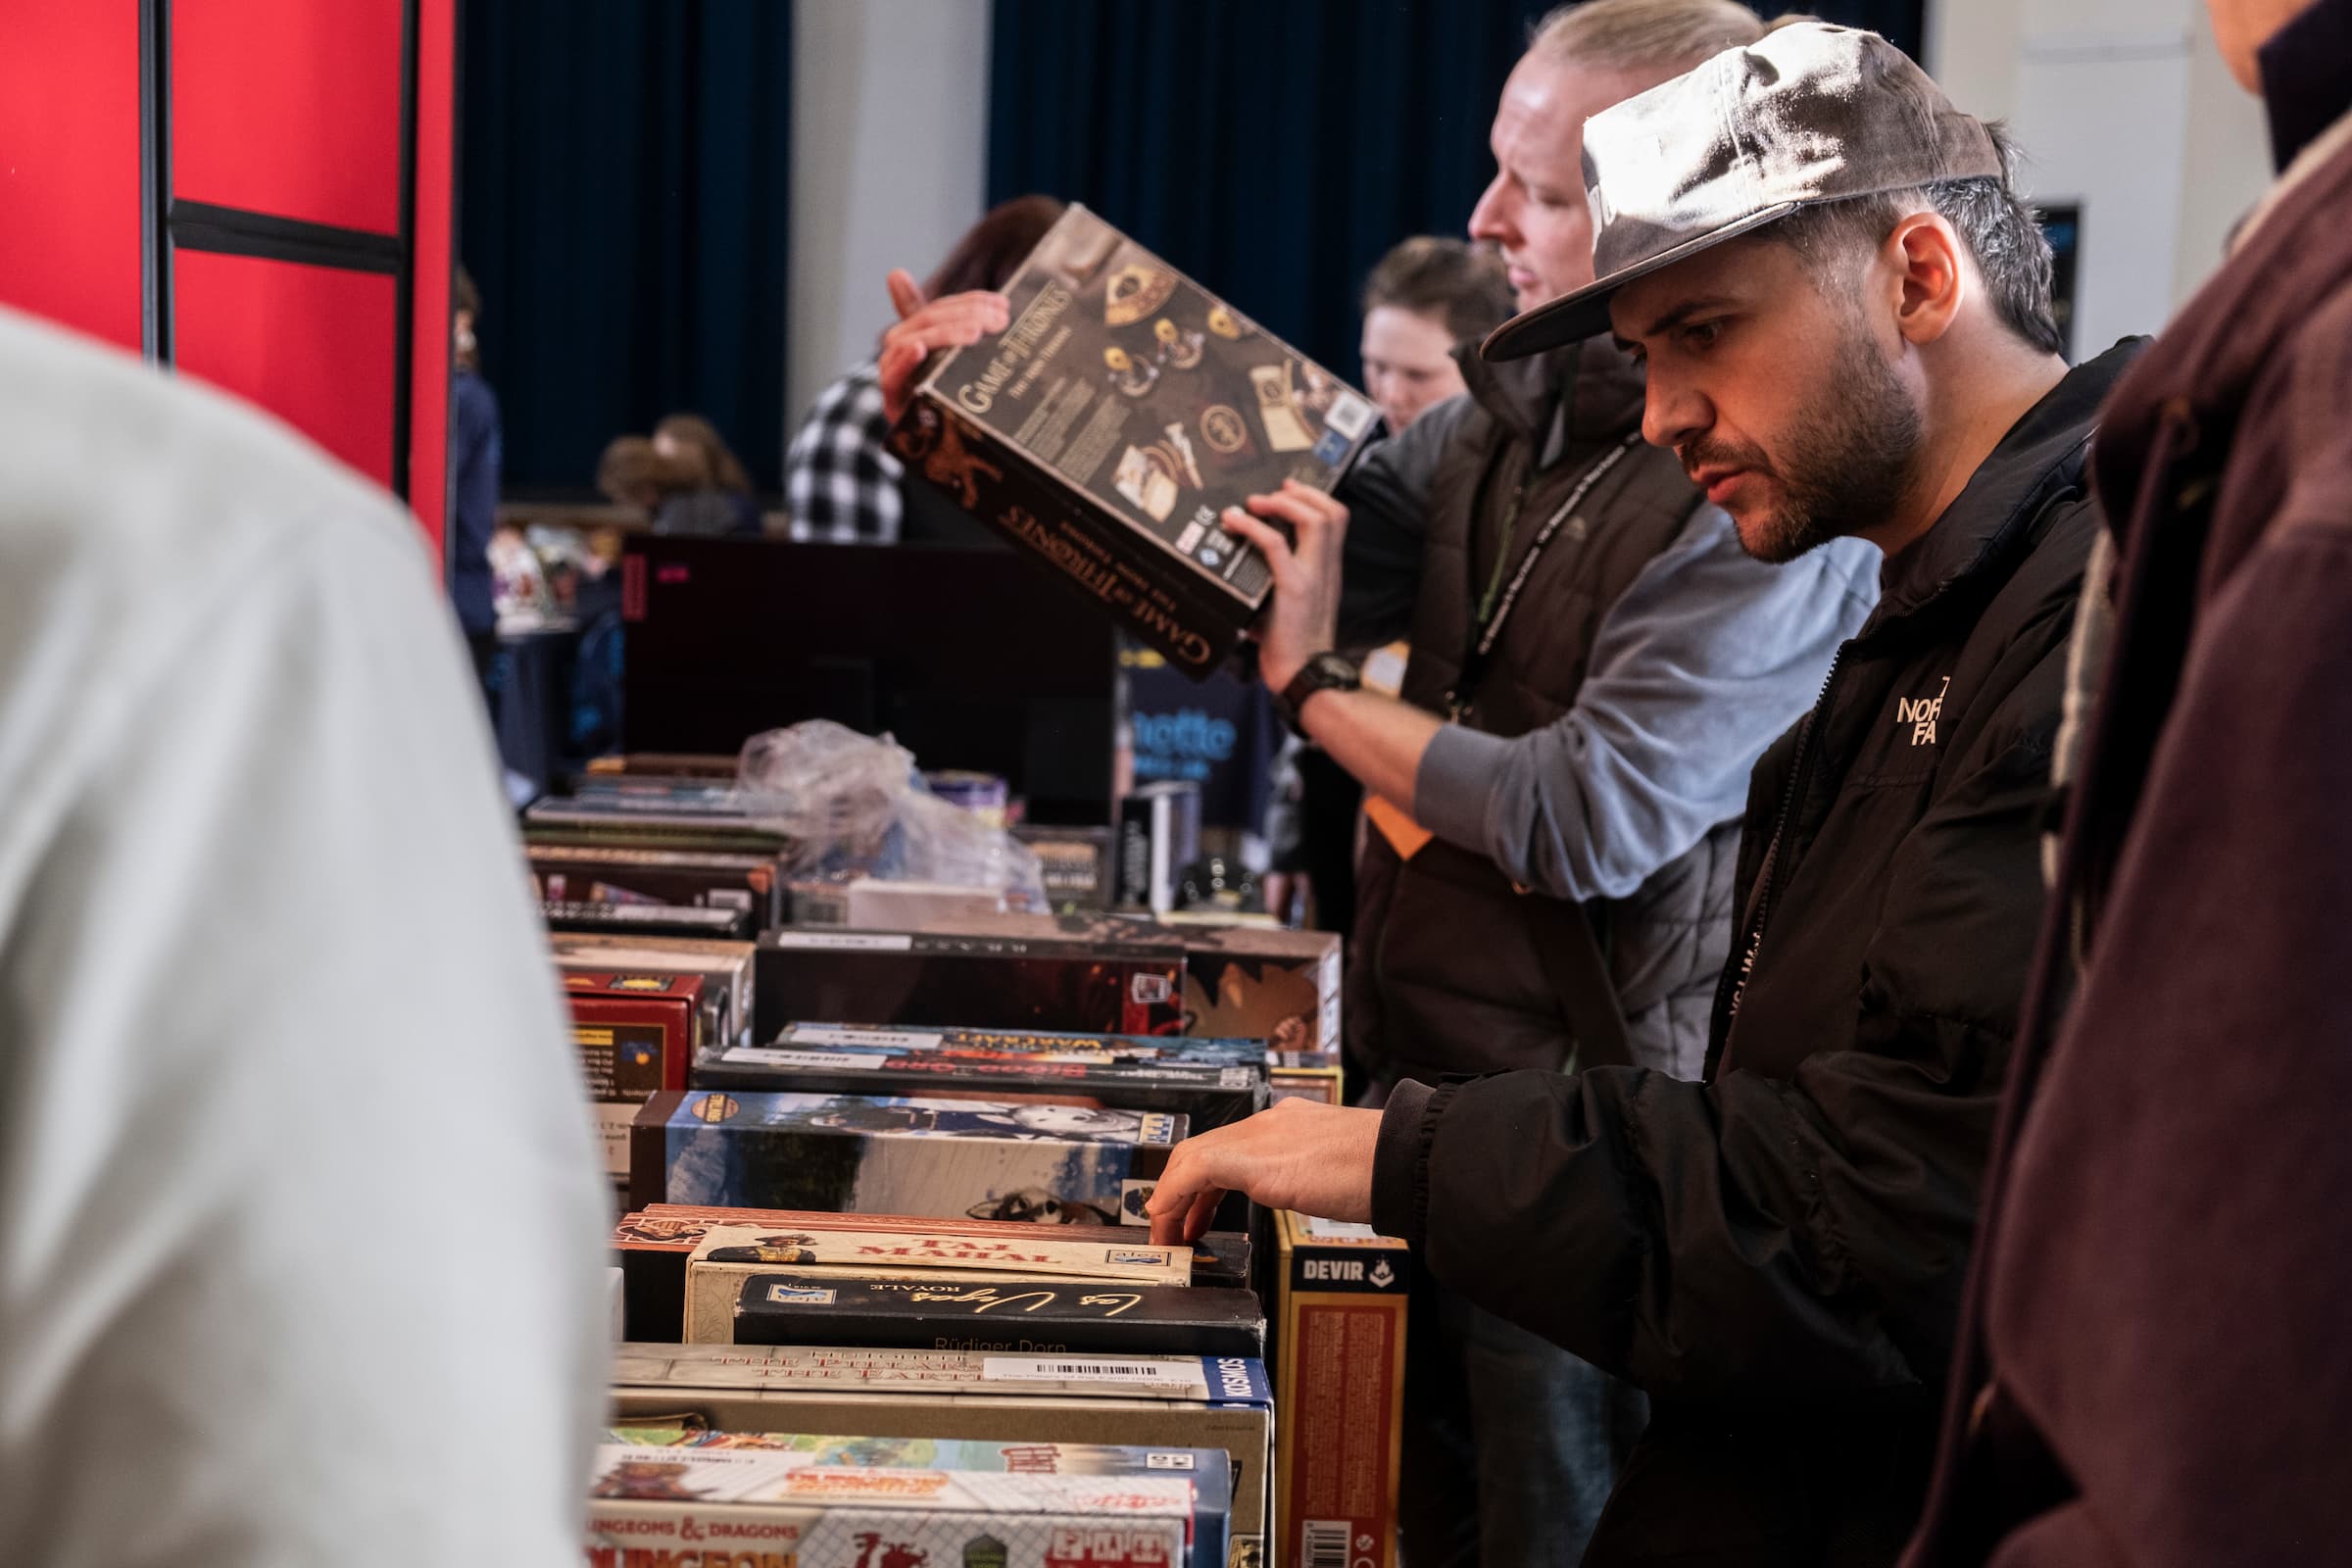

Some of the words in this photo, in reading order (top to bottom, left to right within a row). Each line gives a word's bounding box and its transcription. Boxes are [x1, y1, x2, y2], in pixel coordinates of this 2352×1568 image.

[1897, 697, 1943, 723] NOR
[1912, 720, 1936, 746] FA
[856, 1247, 1062, 1263] MAHAL
[912, 1239, 1012, 1250] TAJ
[1303, 1259, 1364, 1281] DEVIR
[870, 1282, 960, 1294] ROYALE
[910, 1287, 1055, 1314] Vegas
[1079, 1293, 1143, 1317] Las
[934, 1337, 1012, 1351] Rüdiger
[1019, 1339, 1066, 1353] Dorn
[710, 1356, 799, 1365] THE
[813, 1358, 983, 1371] PILLARS
[753, 1368, 841, 1378] THE
[1217, 1357, 1245, 1396] KOSMOS
[680, 1516, 705, 1542] &
[710, 1523, 799, 1540] DRAGONS
